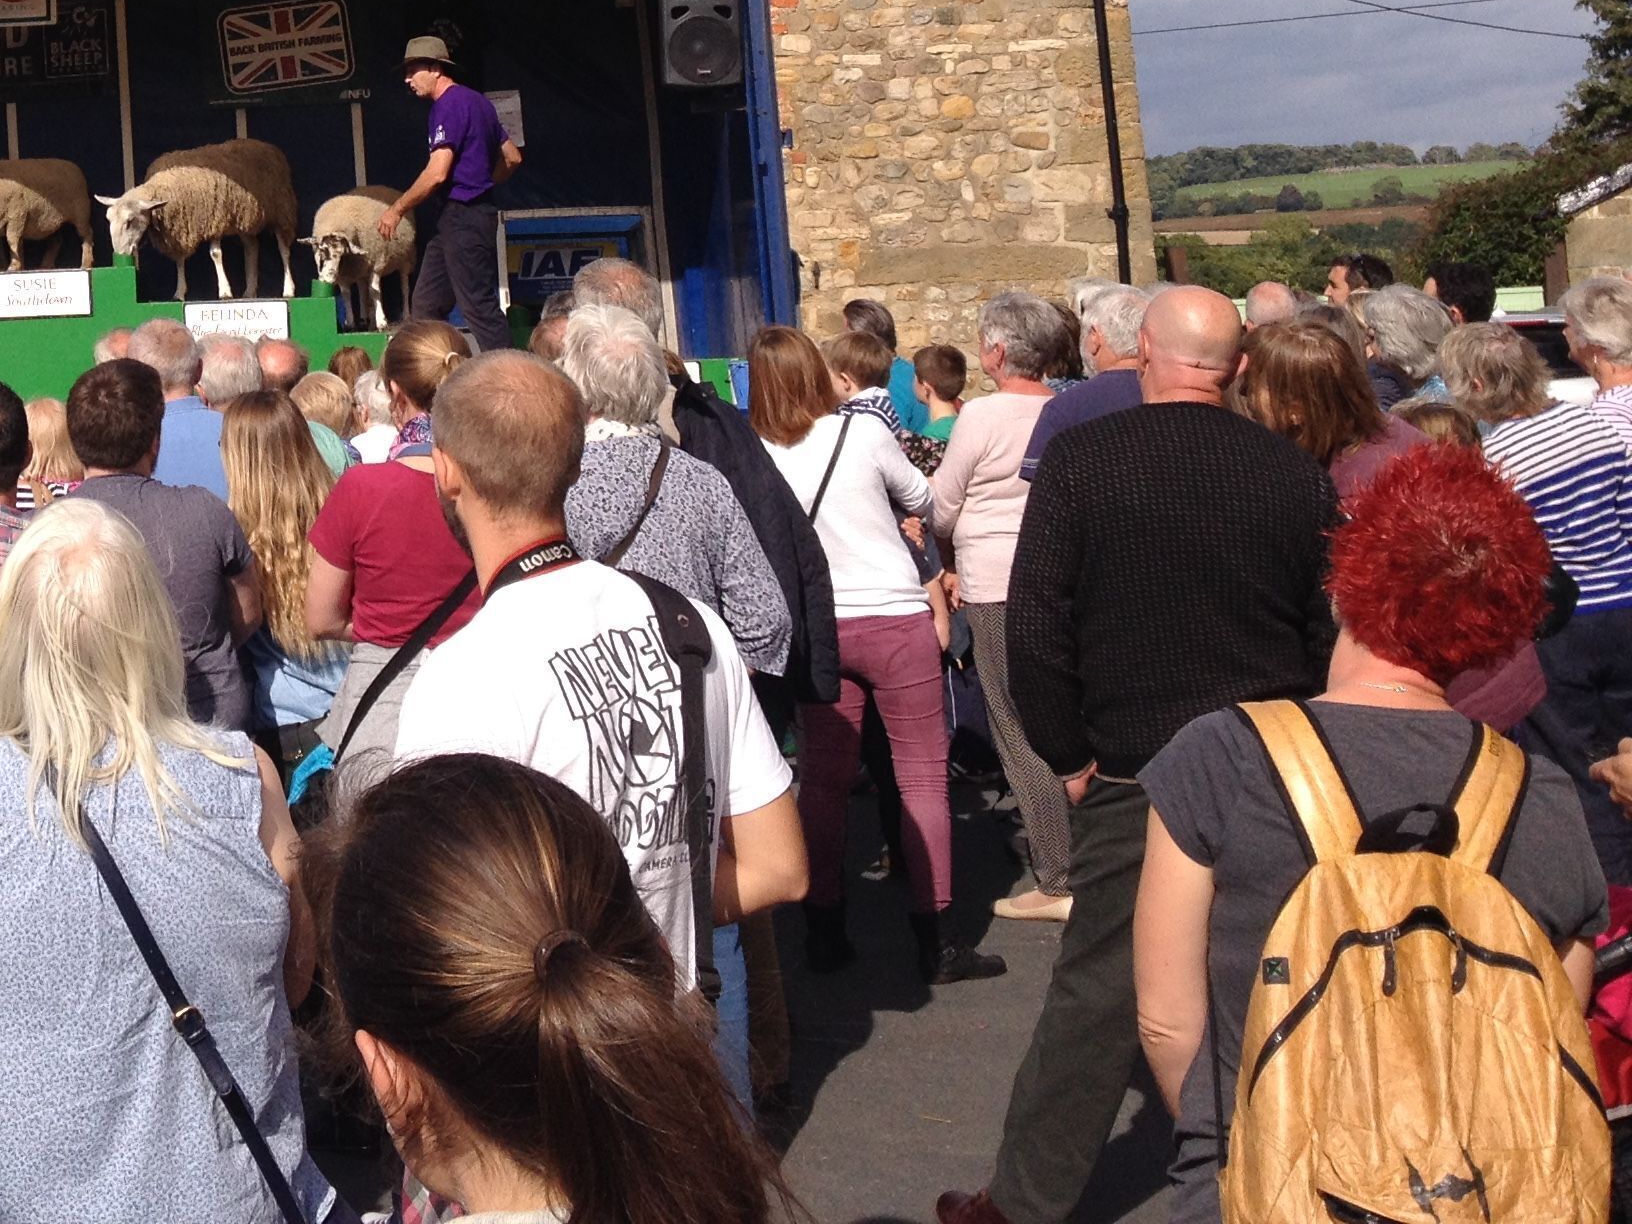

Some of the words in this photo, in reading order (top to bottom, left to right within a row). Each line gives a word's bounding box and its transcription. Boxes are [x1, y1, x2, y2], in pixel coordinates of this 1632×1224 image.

[50, 38, 102, 53] BLACK
[229, 45, 256, 57] BACK
[258, 40, 296, 53] BRITISH
[298, 32, 343, 47] FARMING
[50, 51, 103, 67] SHEEP
[348, 88, 371, 99] NFU
[14, 278, 57, 291] SUSIE
[6, 293, 73, 306] Southdown
[201, 308, 269, 321] BELINDA
[519, 544, 573, 572] Canon
